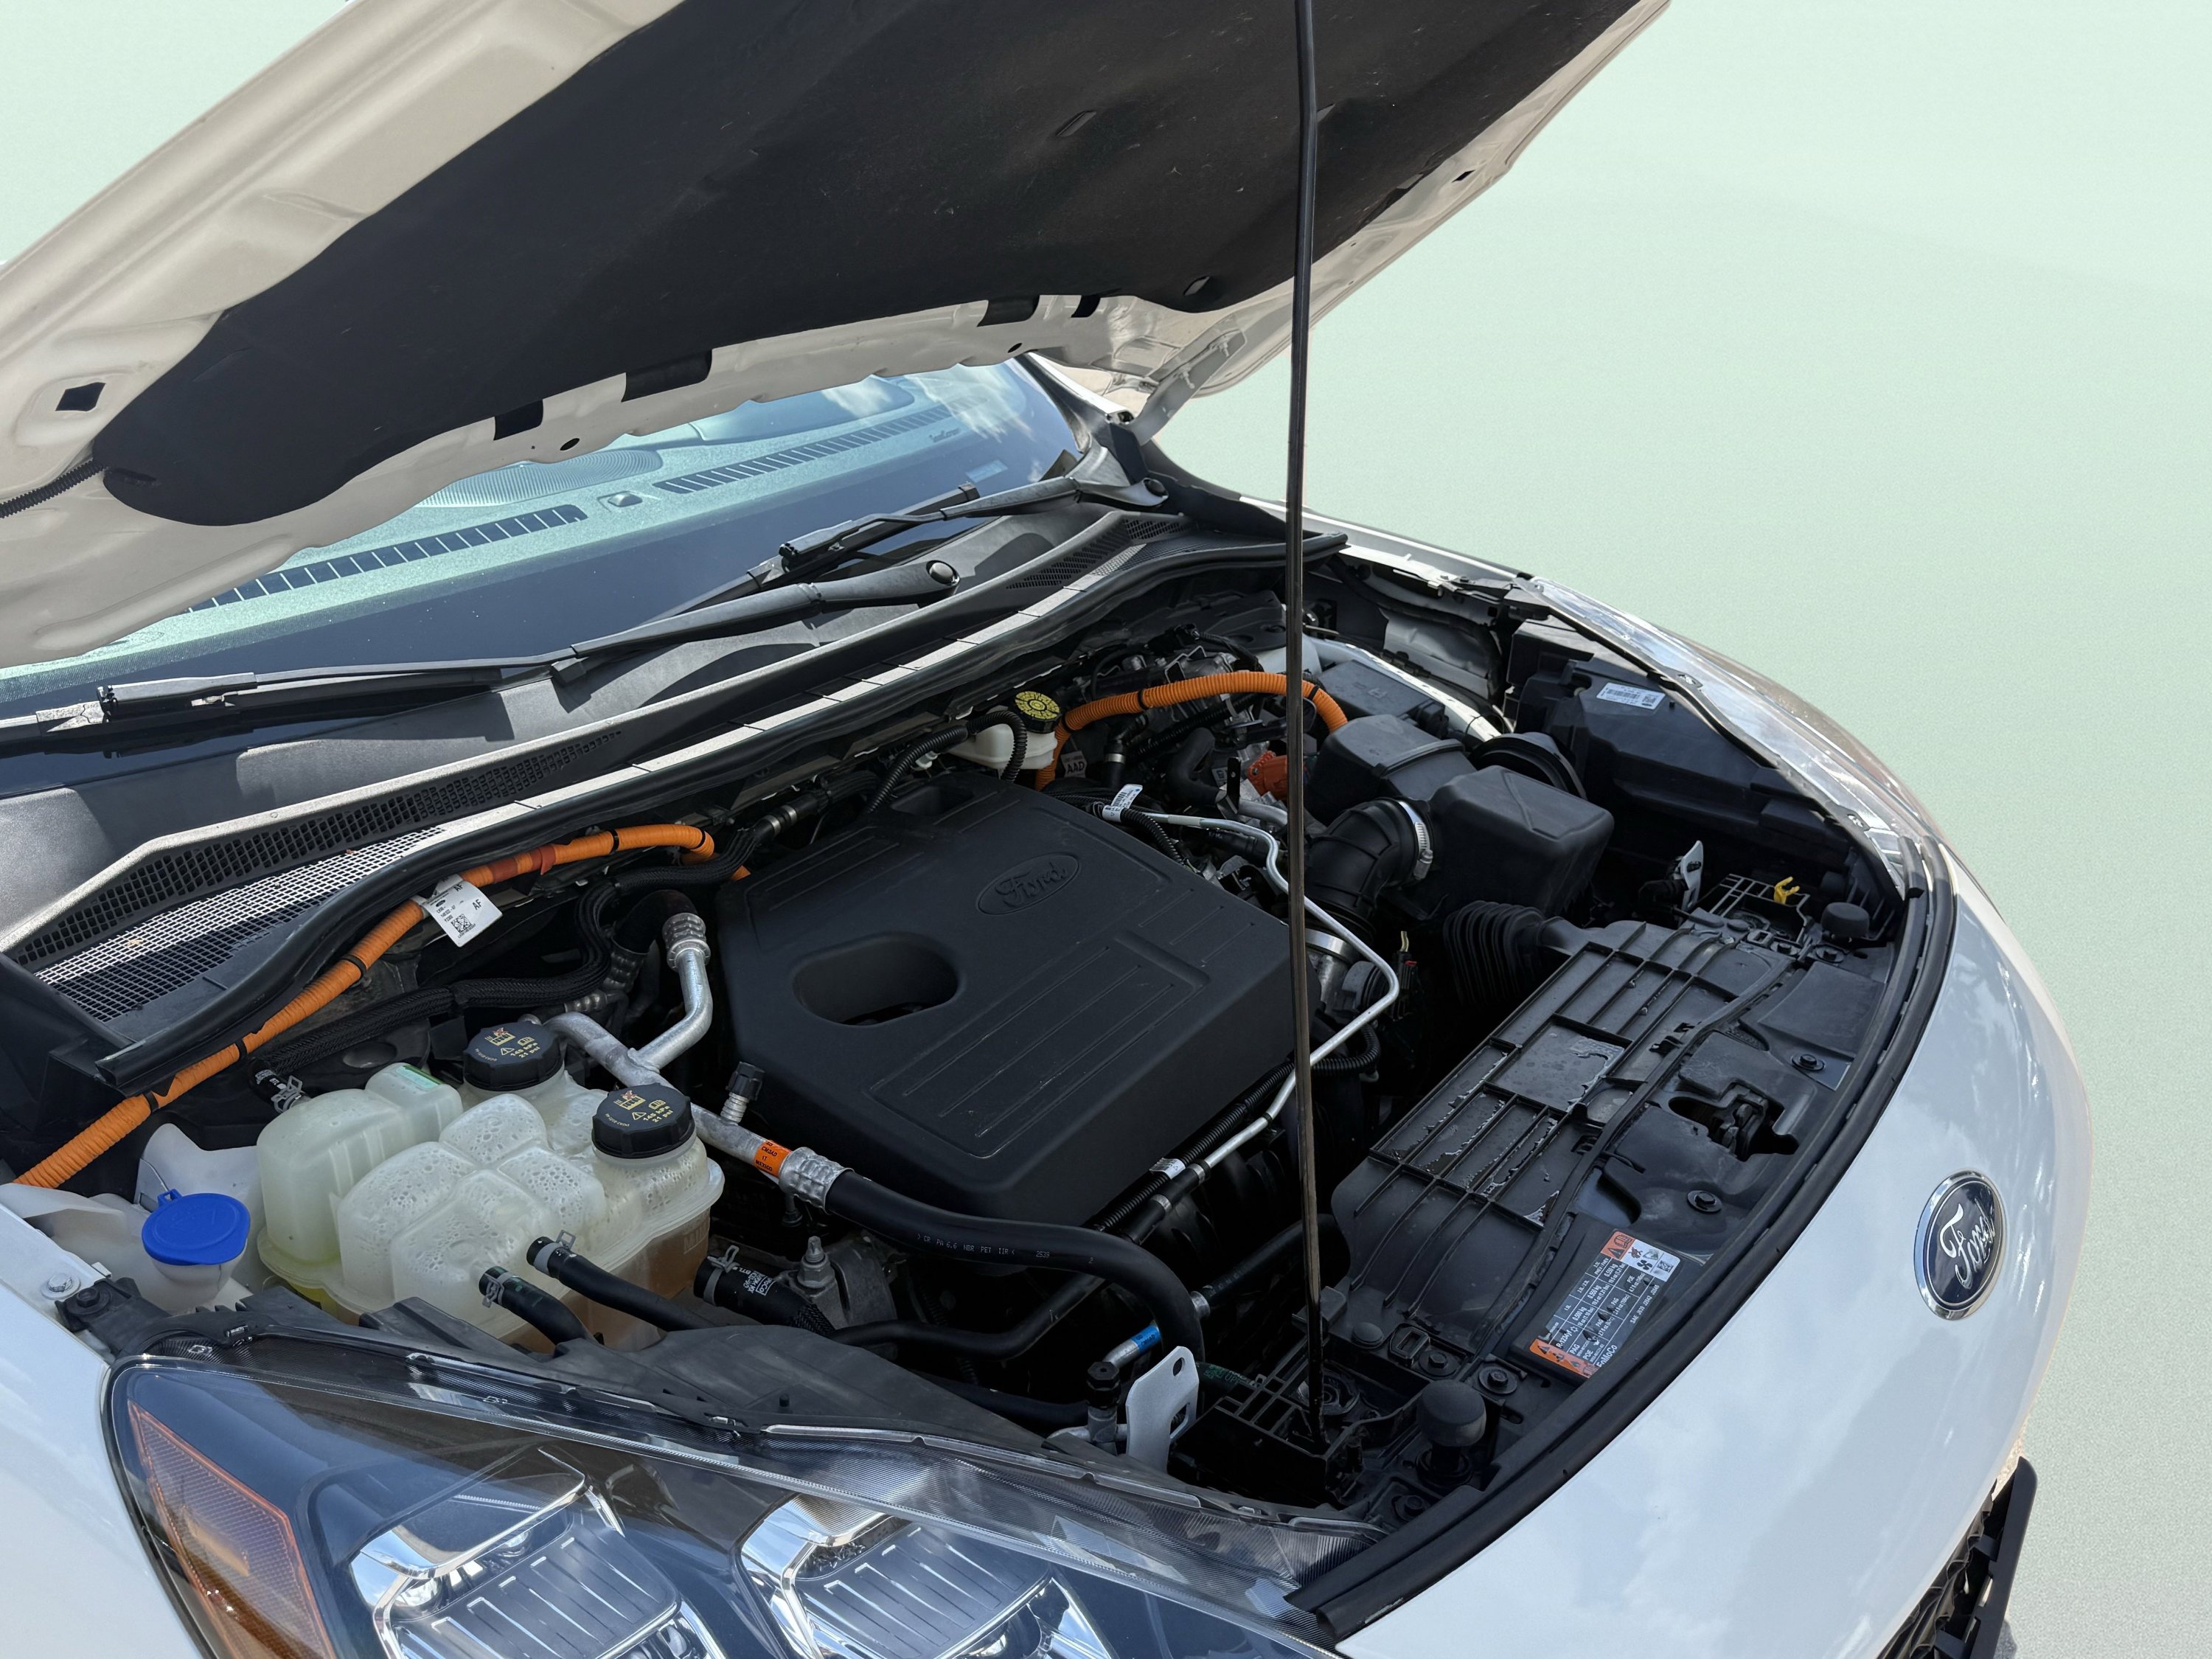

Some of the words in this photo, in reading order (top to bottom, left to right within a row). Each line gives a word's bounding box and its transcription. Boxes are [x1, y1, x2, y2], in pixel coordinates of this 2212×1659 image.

[1067, 761, 1085, 774] AAD
[995, 861, 1067, 908] Ford
[472, 899, 481, 910] AF
[643, 1113, 656, 1121] 145
[1939, 1197, 1996, 1290] Ford
[1610, 1296, 1619, 1305] PAG
[1629, 1314, 1639, 1324] SAE
[1555, 1329, 1573, 1348] R-1234yf
[1569, 1343, 1580, 1354] PAG
[1582, 1349, 1593, 1360] POE
[1596, 1343, 1618, 1368] FoMoCo
